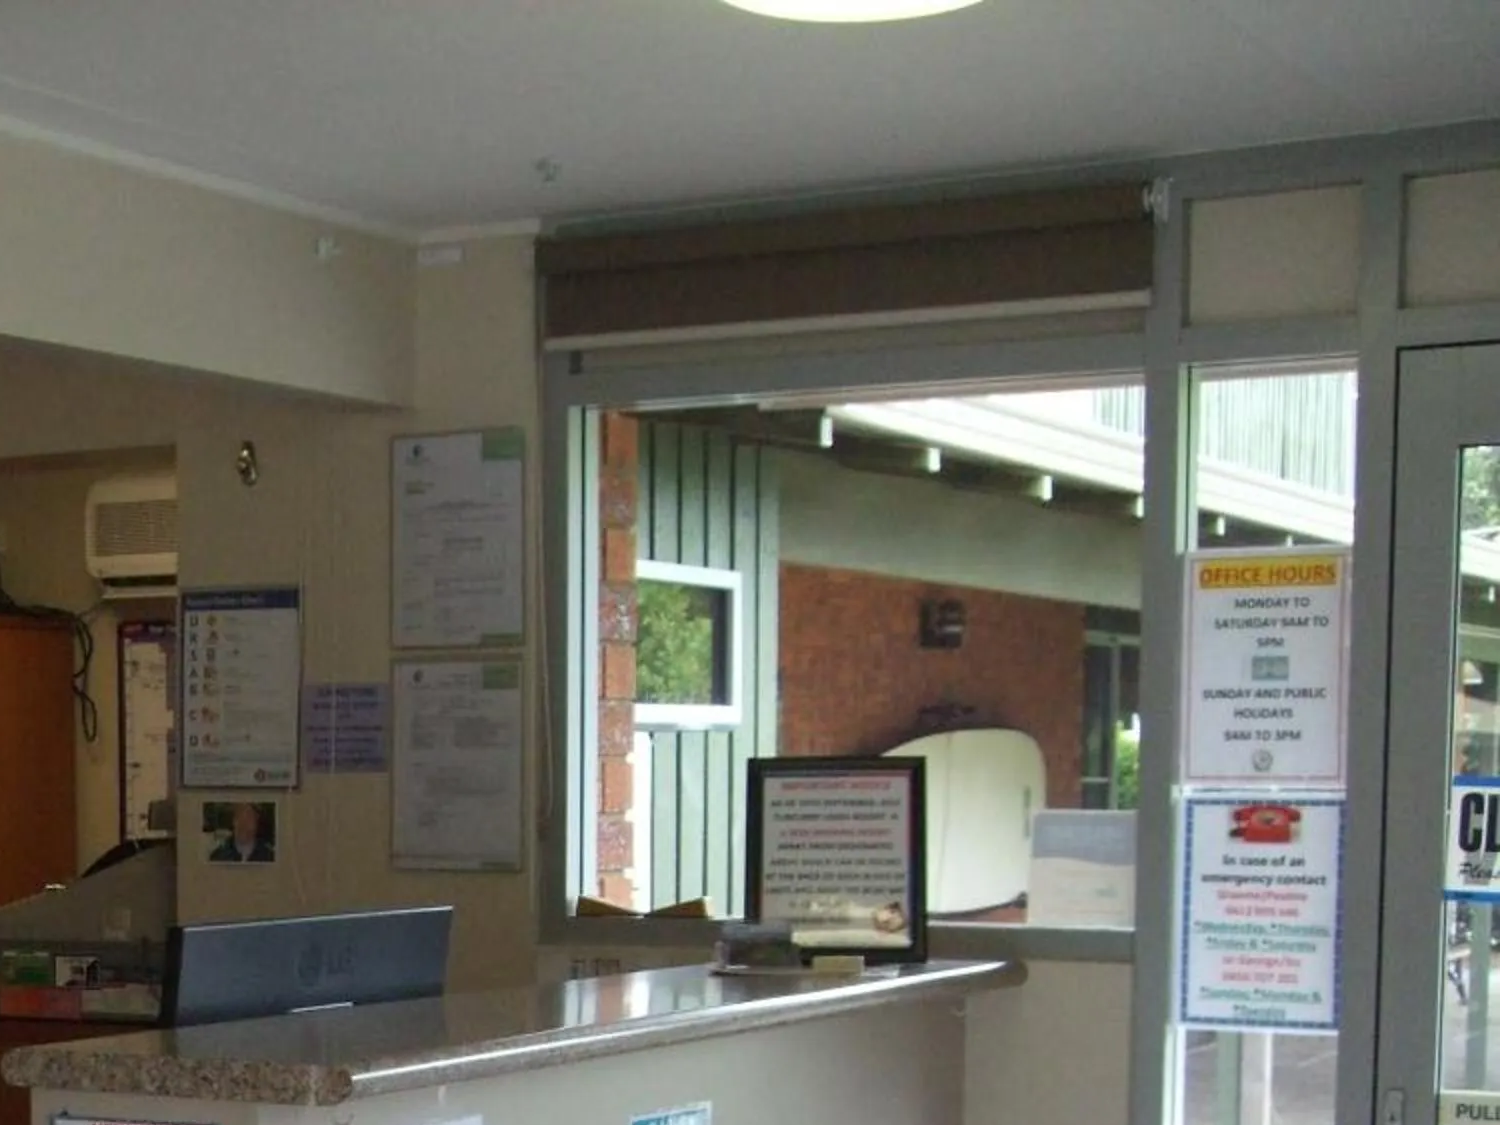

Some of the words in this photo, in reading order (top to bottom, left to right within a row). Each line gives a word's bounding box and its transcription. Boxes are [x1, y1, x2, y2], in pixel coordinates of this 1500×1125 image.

[1200, 568, 1261, 585] OFFICE
[1269, 564, 1336, 583] HOURS
[1234, 597, 1289, 609] MONDAY
[1294, 597, 1310, 608] TO
[1214, 617, 1276, 630] SATURDAY
[1313, 616, 1329, 627] TO
[1203, 688, 1251, 700] SUNDAY
[1254, 687, 1281, 699] AND
[1284, 687, 1327, 699] PUBLIC
[1233, 707, 1294, 719] HOLIDAYS
[1255, 730, 1271, 741] TO
[1240, 856, 1268, 866] case
[1271, 855, 1286, 867] of
[1289, 857, 1305, 867] an
[1201, 874, 1274, 886] emergency
[1276, 875, 1327, 886] contact
